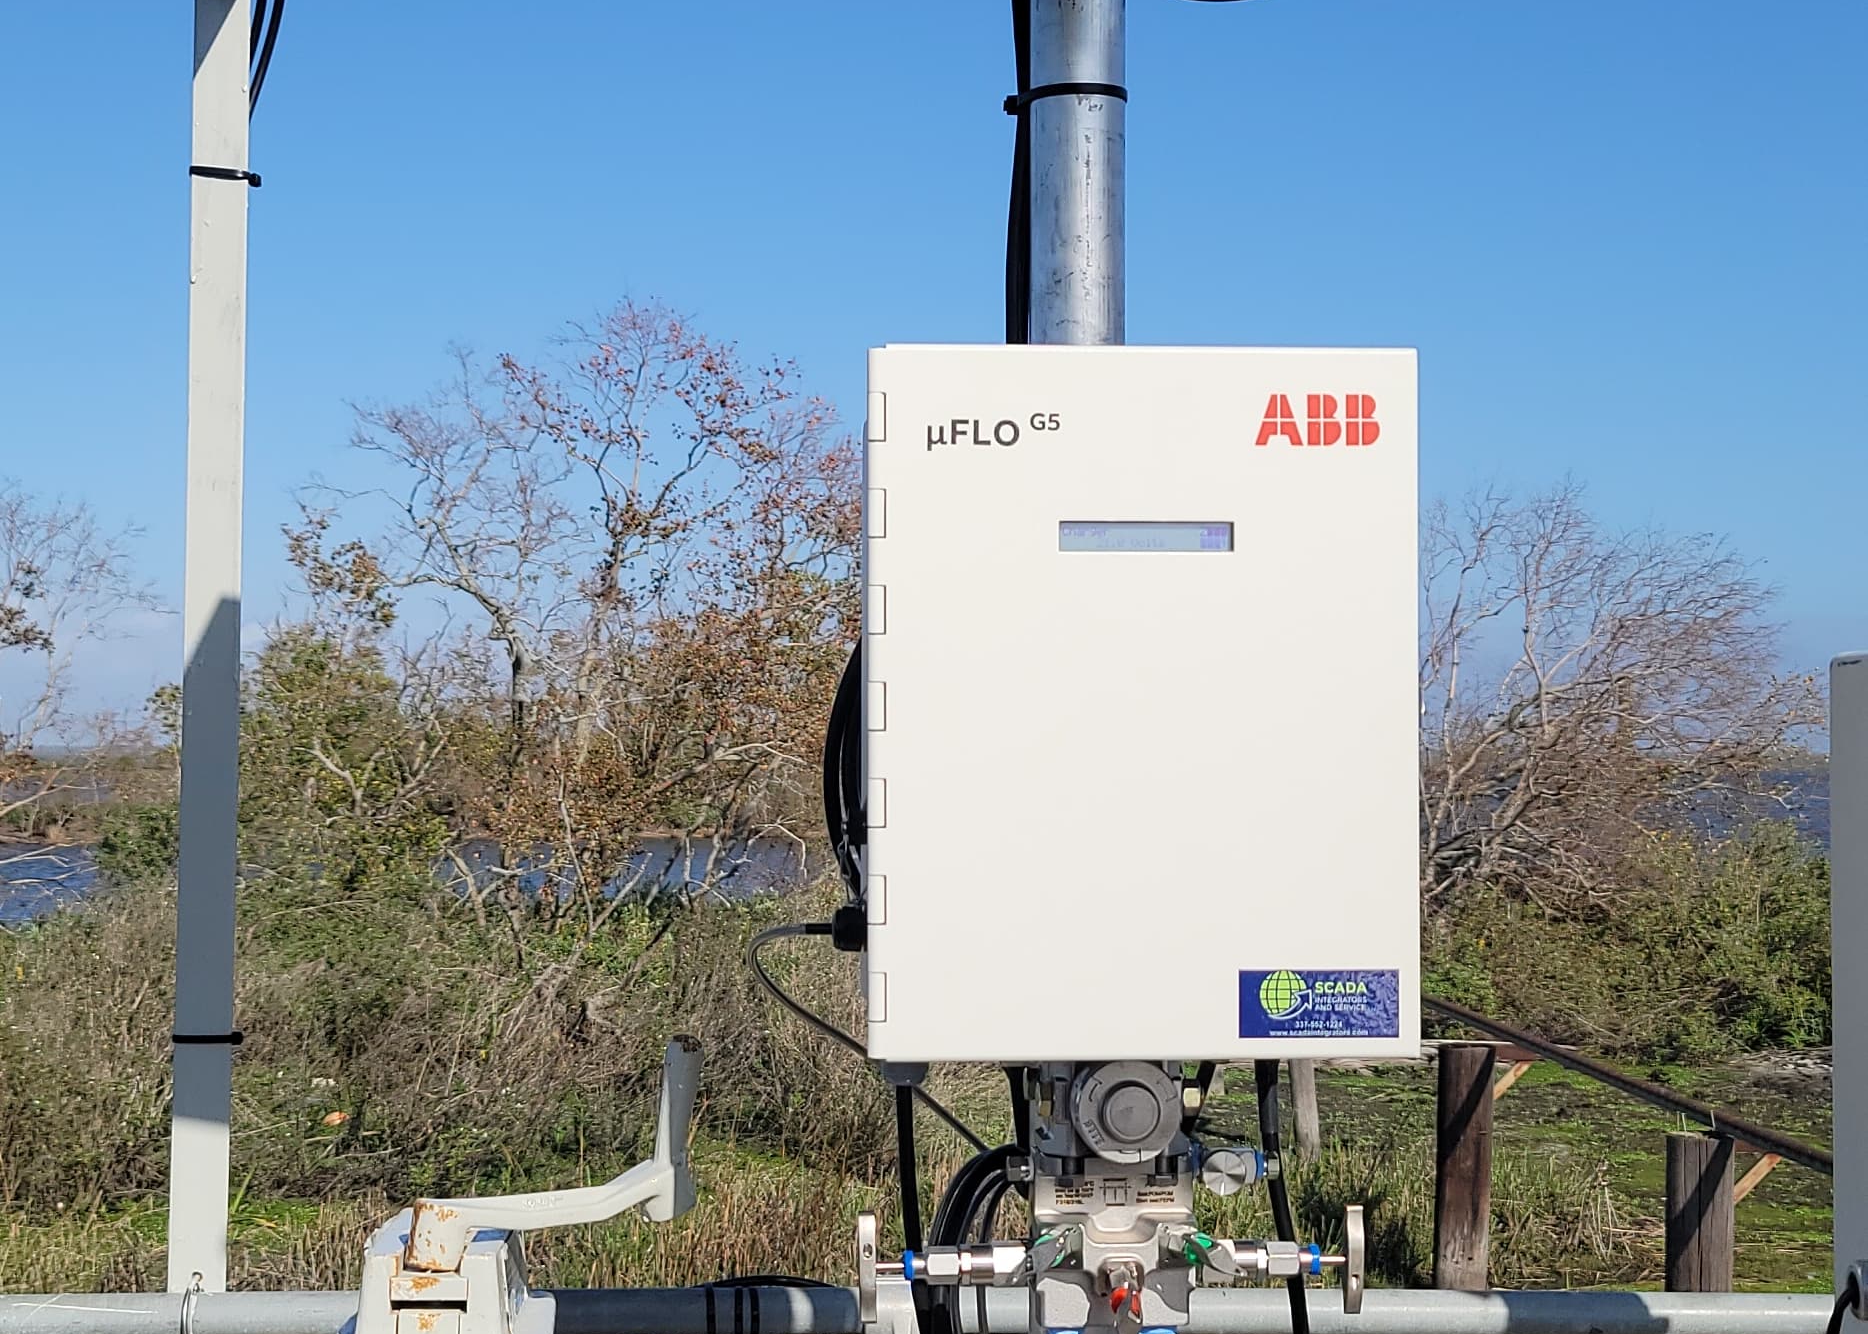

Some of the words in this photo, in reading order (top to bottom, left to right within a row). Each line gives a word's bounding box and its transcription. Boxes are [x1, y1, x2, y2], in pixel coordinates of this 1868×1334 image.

[1255, 394, 1380, 446] ABB
[927, 419, 1020, 451] µFLO
[1030, 413, 1061, 431] G5
[1314, 981, 1368, 994] SCADA
[1314, 996, 1368, 1004] INTEGRATORS
[1314, 1003, 1333, 1012] AND
